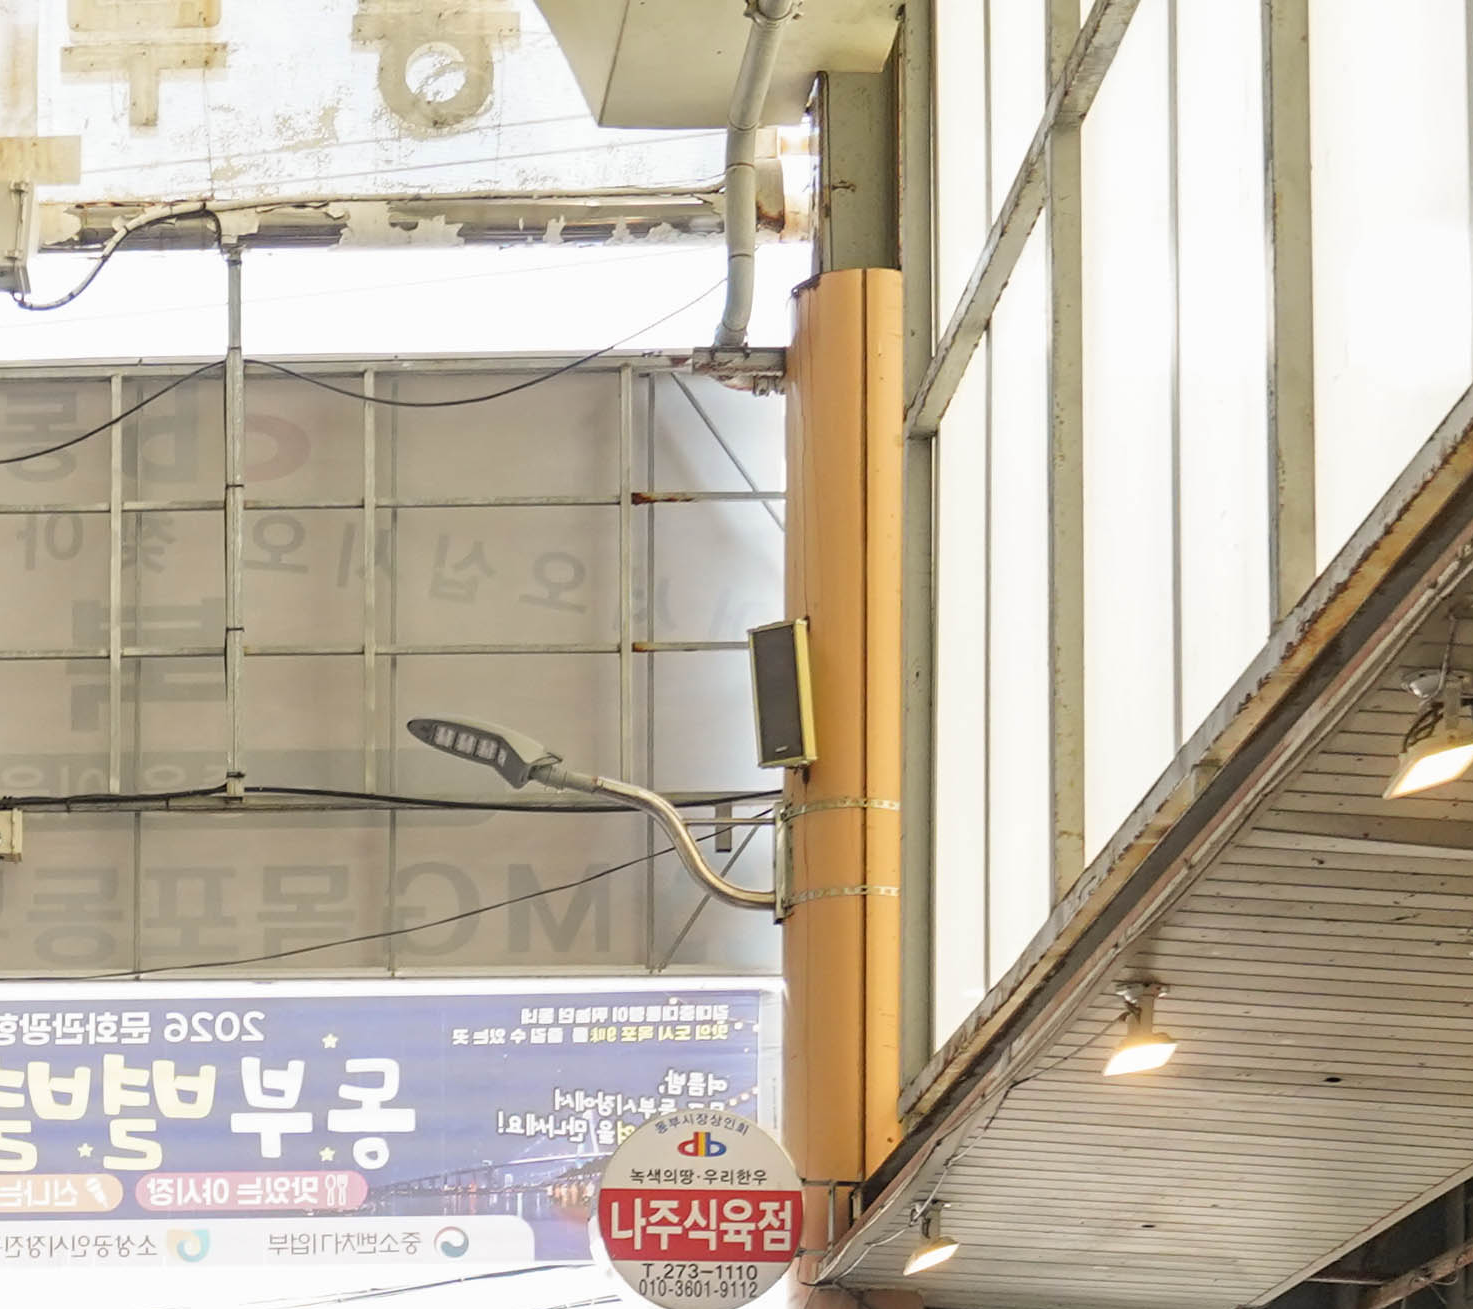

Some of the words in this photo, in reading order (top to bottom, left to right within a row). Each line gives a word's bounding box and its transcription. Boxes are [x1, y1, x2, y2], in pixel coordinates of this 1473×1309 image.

[654, 1113, 750, 1136] 동부시장상인회
[611, 1197, 793, 1252] 나주식육점
[642, 1263, 758, 1281] T.273-1110
[639, 1280, 759, 1298] 010-3601-9112
